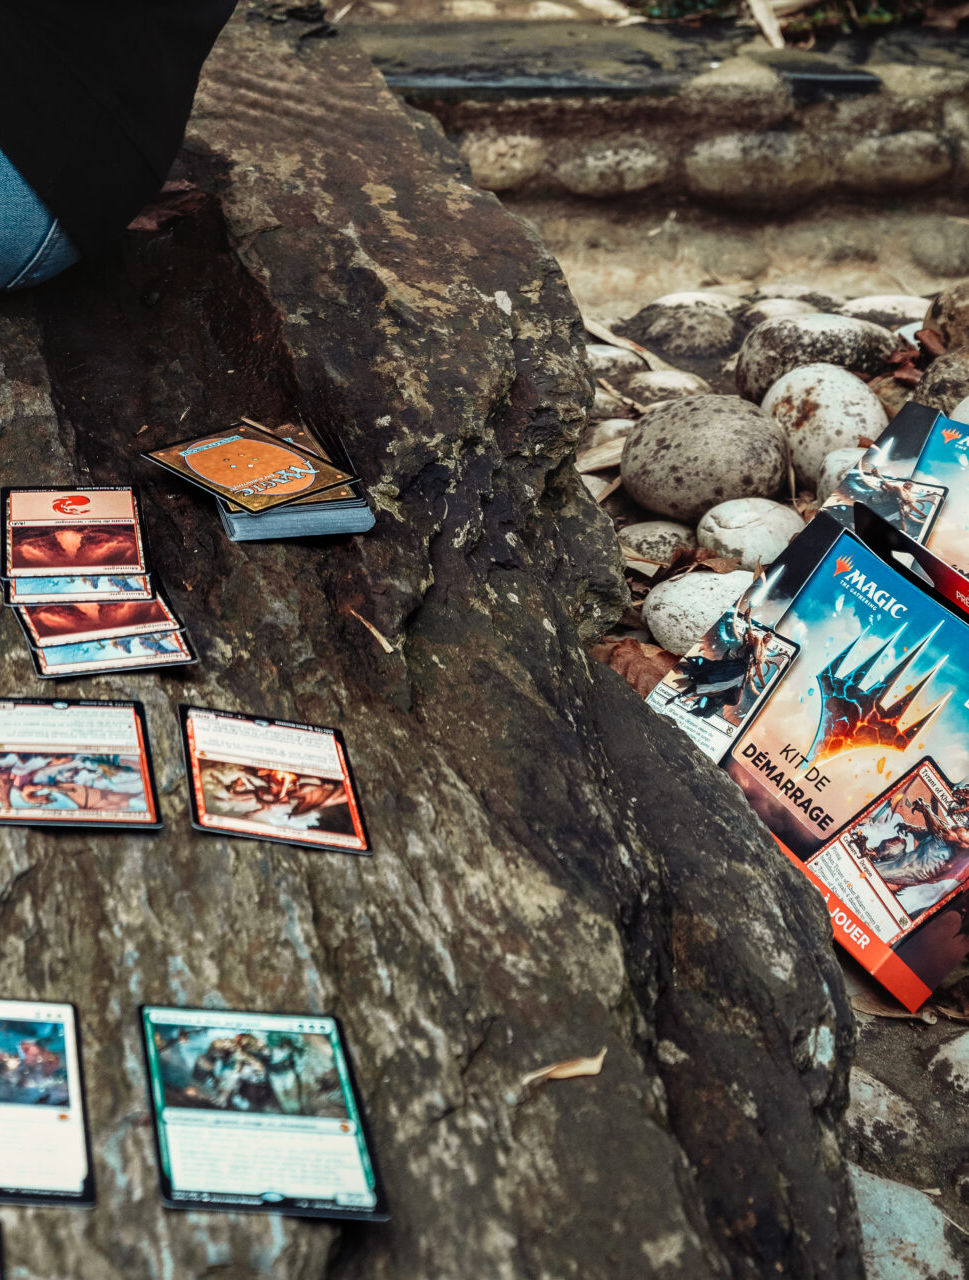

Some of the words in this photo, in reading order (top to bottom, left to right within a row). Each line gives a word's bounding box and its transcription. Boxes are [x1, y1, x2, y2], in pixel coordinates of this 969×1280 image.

[233, 460, 320, 496] MAGIC
[840, 580, 851, 589] THE
[850, 587, 878, 611] GATHERING
[844, 568, 909, 620] MAGIC
[741, 742, 835, 832] DÉMARRAGE
[779, 743, 809, 769] KIT
[804, 767, 831, 792] DE
[921, 768, 936, 787] Tyrant
[830, 905, 871, 950] JOUER
